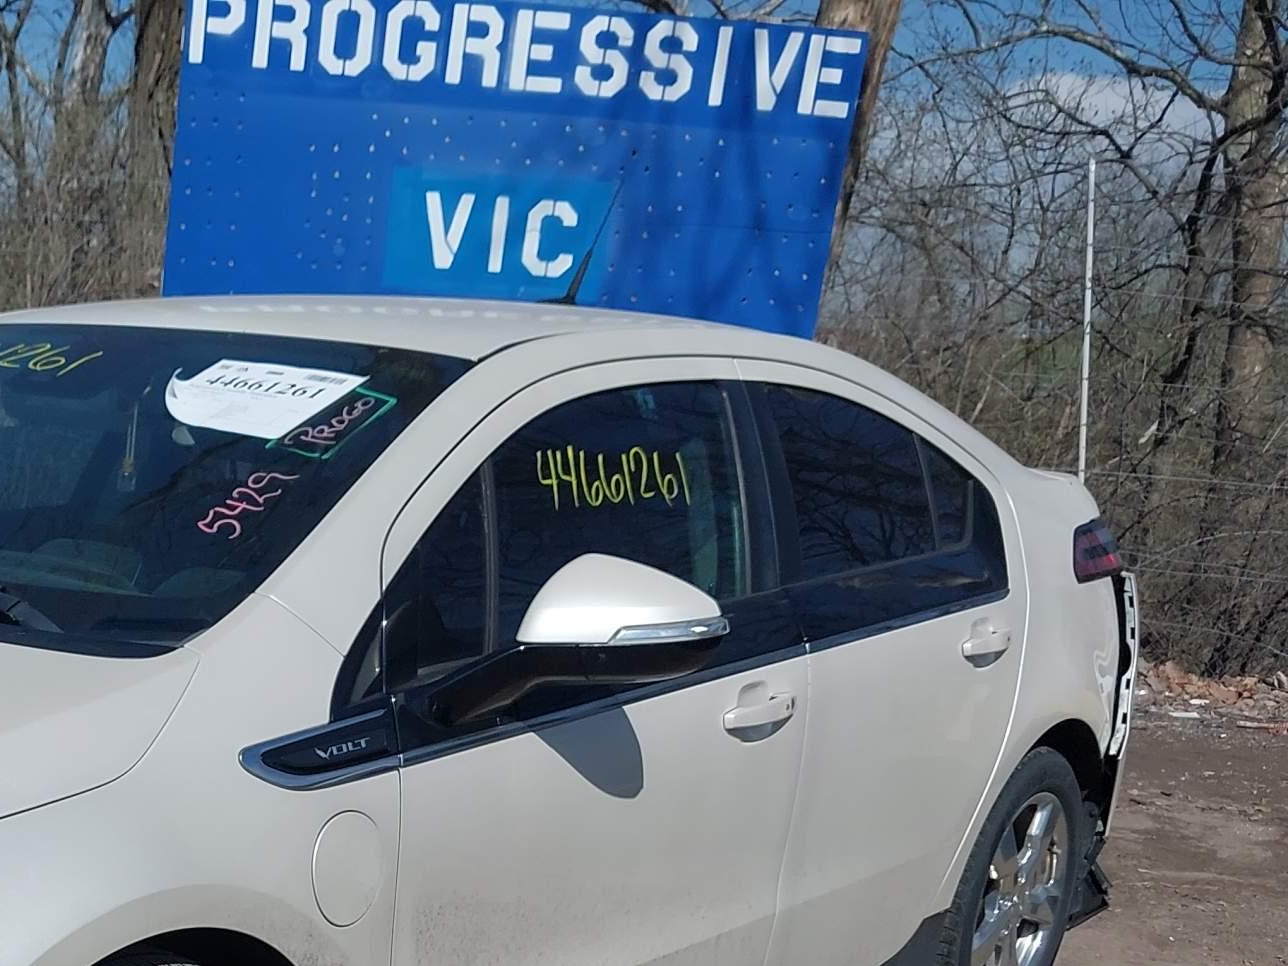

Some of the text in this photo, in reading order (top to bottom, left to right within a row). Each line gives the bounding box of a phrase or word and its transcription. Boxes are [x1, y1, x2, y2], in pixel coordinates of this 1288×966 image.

[188, 0, 862, 118] PROGRESSIVE
[425, 191, 578, 278] VIC
[206, 374, 325, 399] 44661261
[197, 472, 300, 539] 5429
[536, 445, 691, 511] 44661261
[314, 737, 371, 760] VOLT
